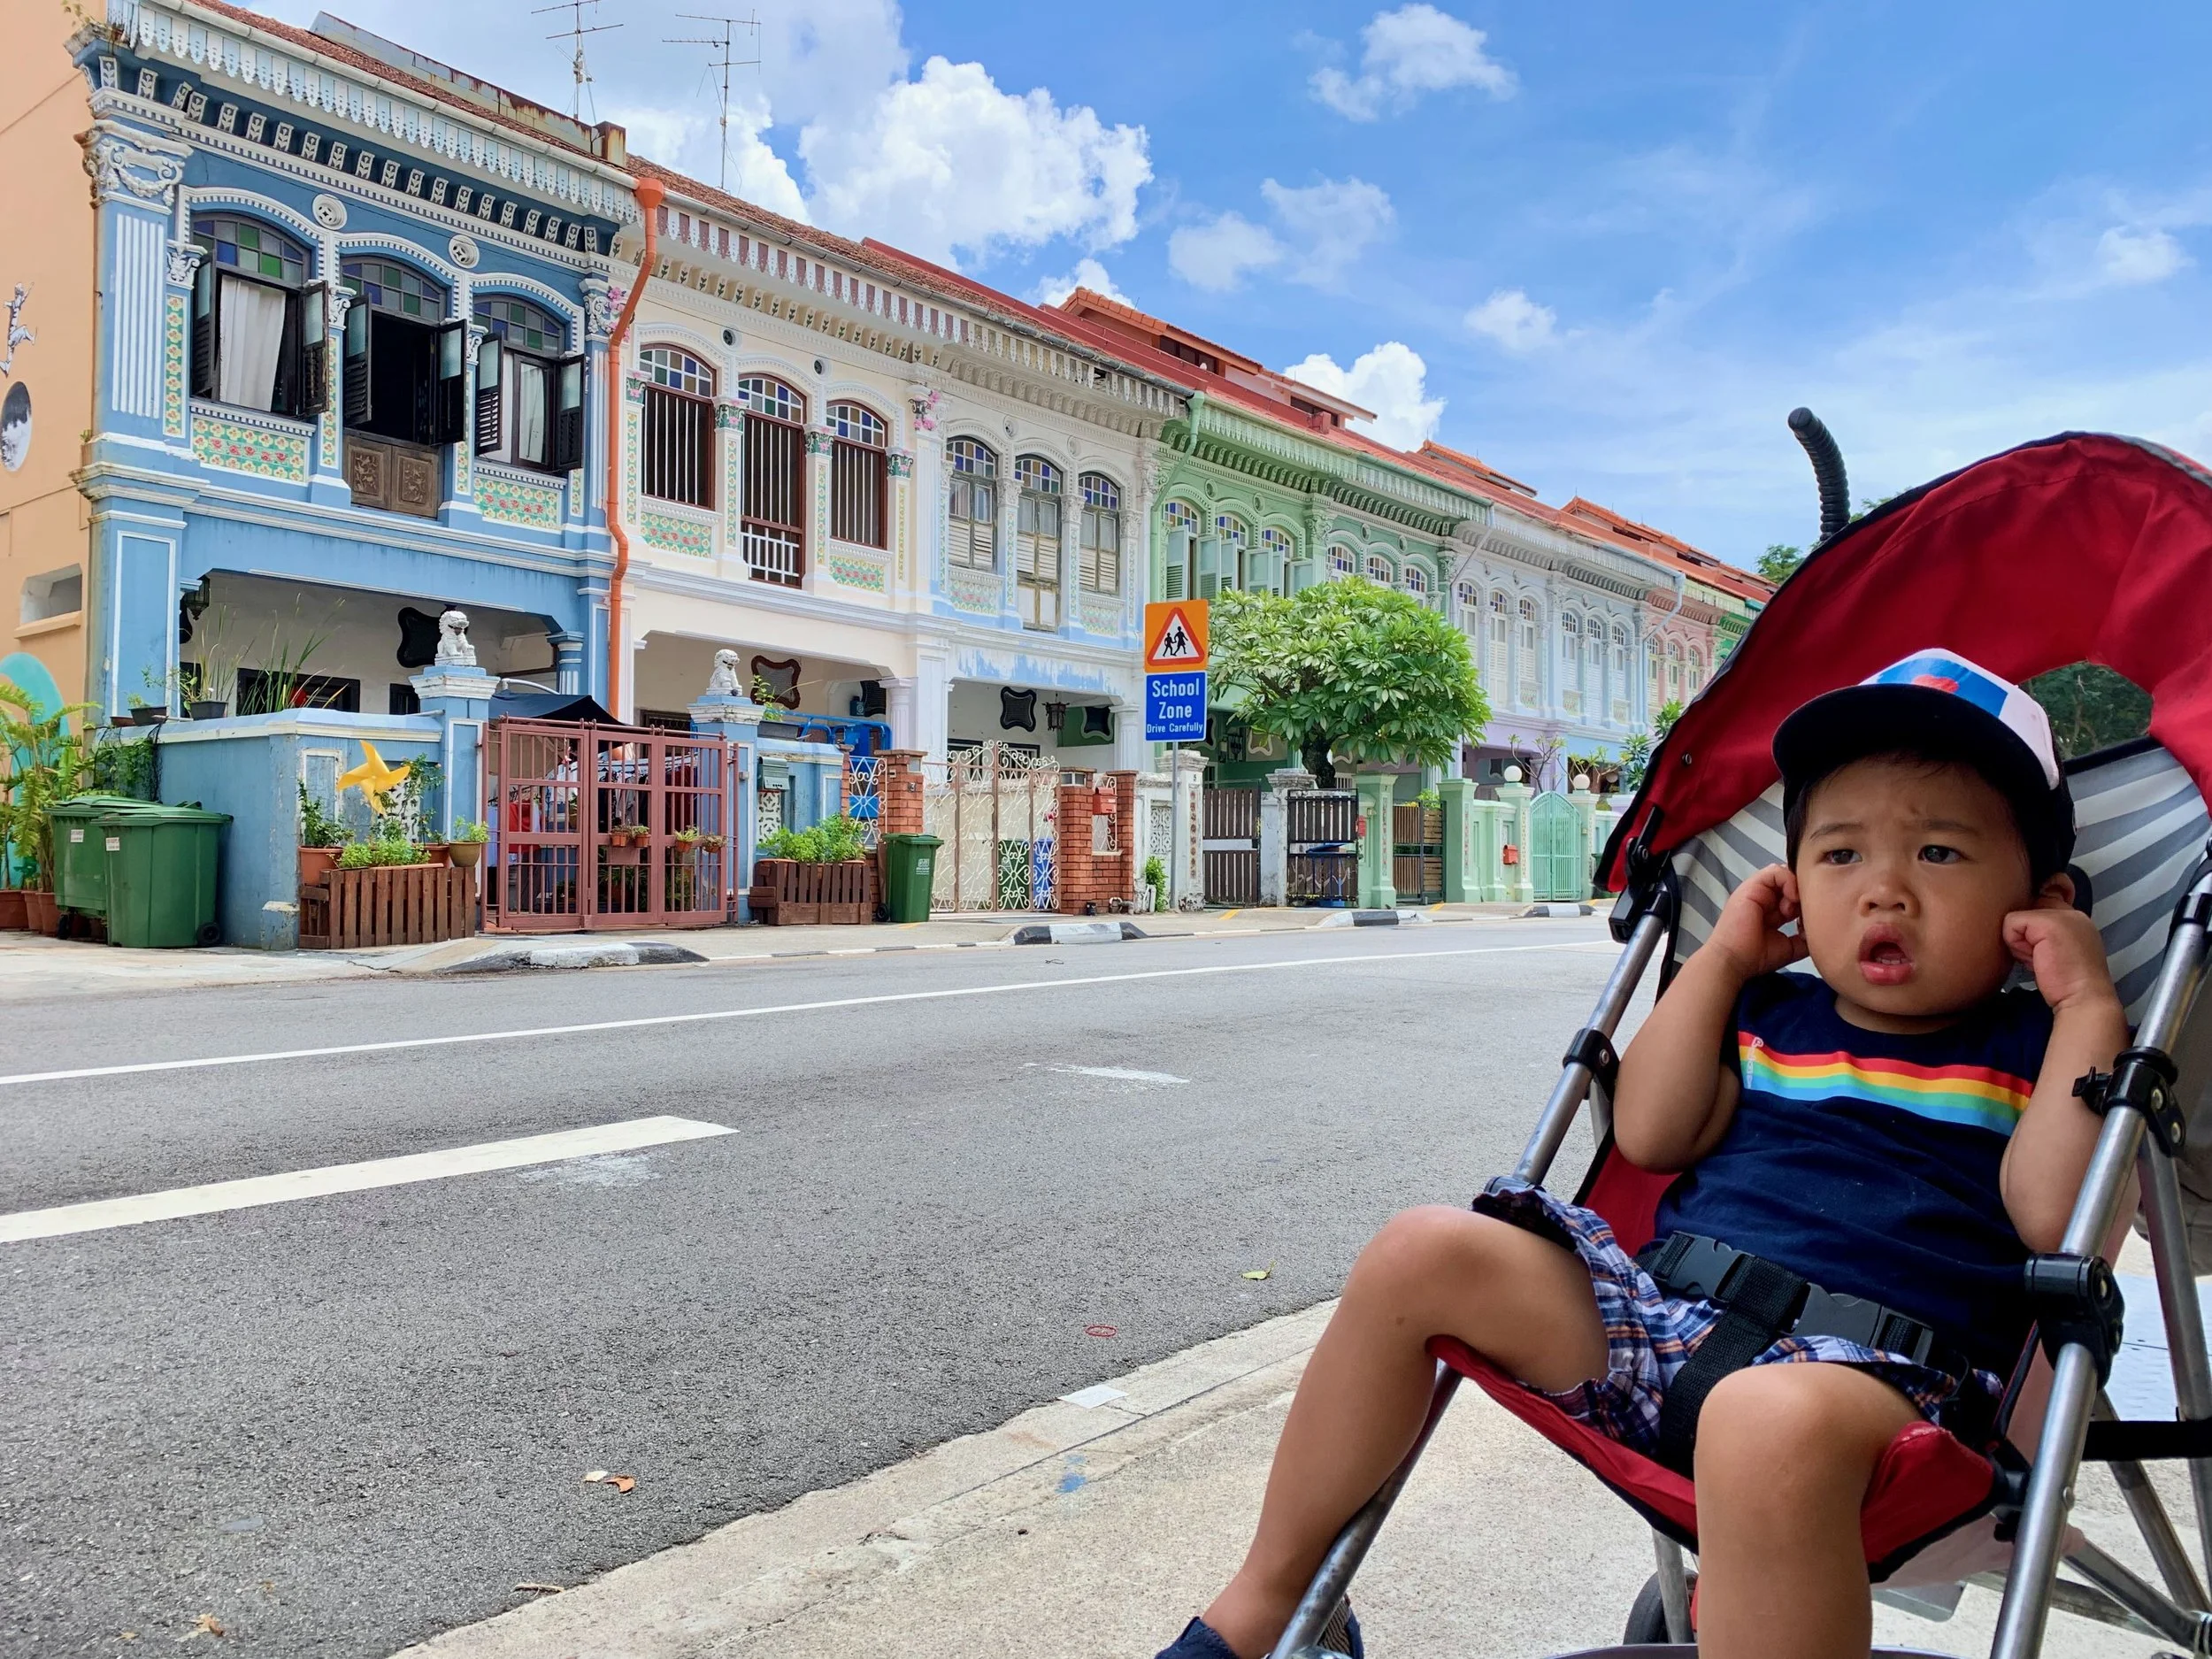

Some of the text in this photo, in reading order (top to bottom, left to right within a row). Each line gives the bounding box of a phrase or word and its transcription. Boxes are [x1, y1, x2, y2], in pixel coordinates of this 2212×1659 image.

[1152, 678, 1200, 697] School
[1158, 702, 1192, 719] Zone
[1147, 722, 1203, 733] Drive Carefully
